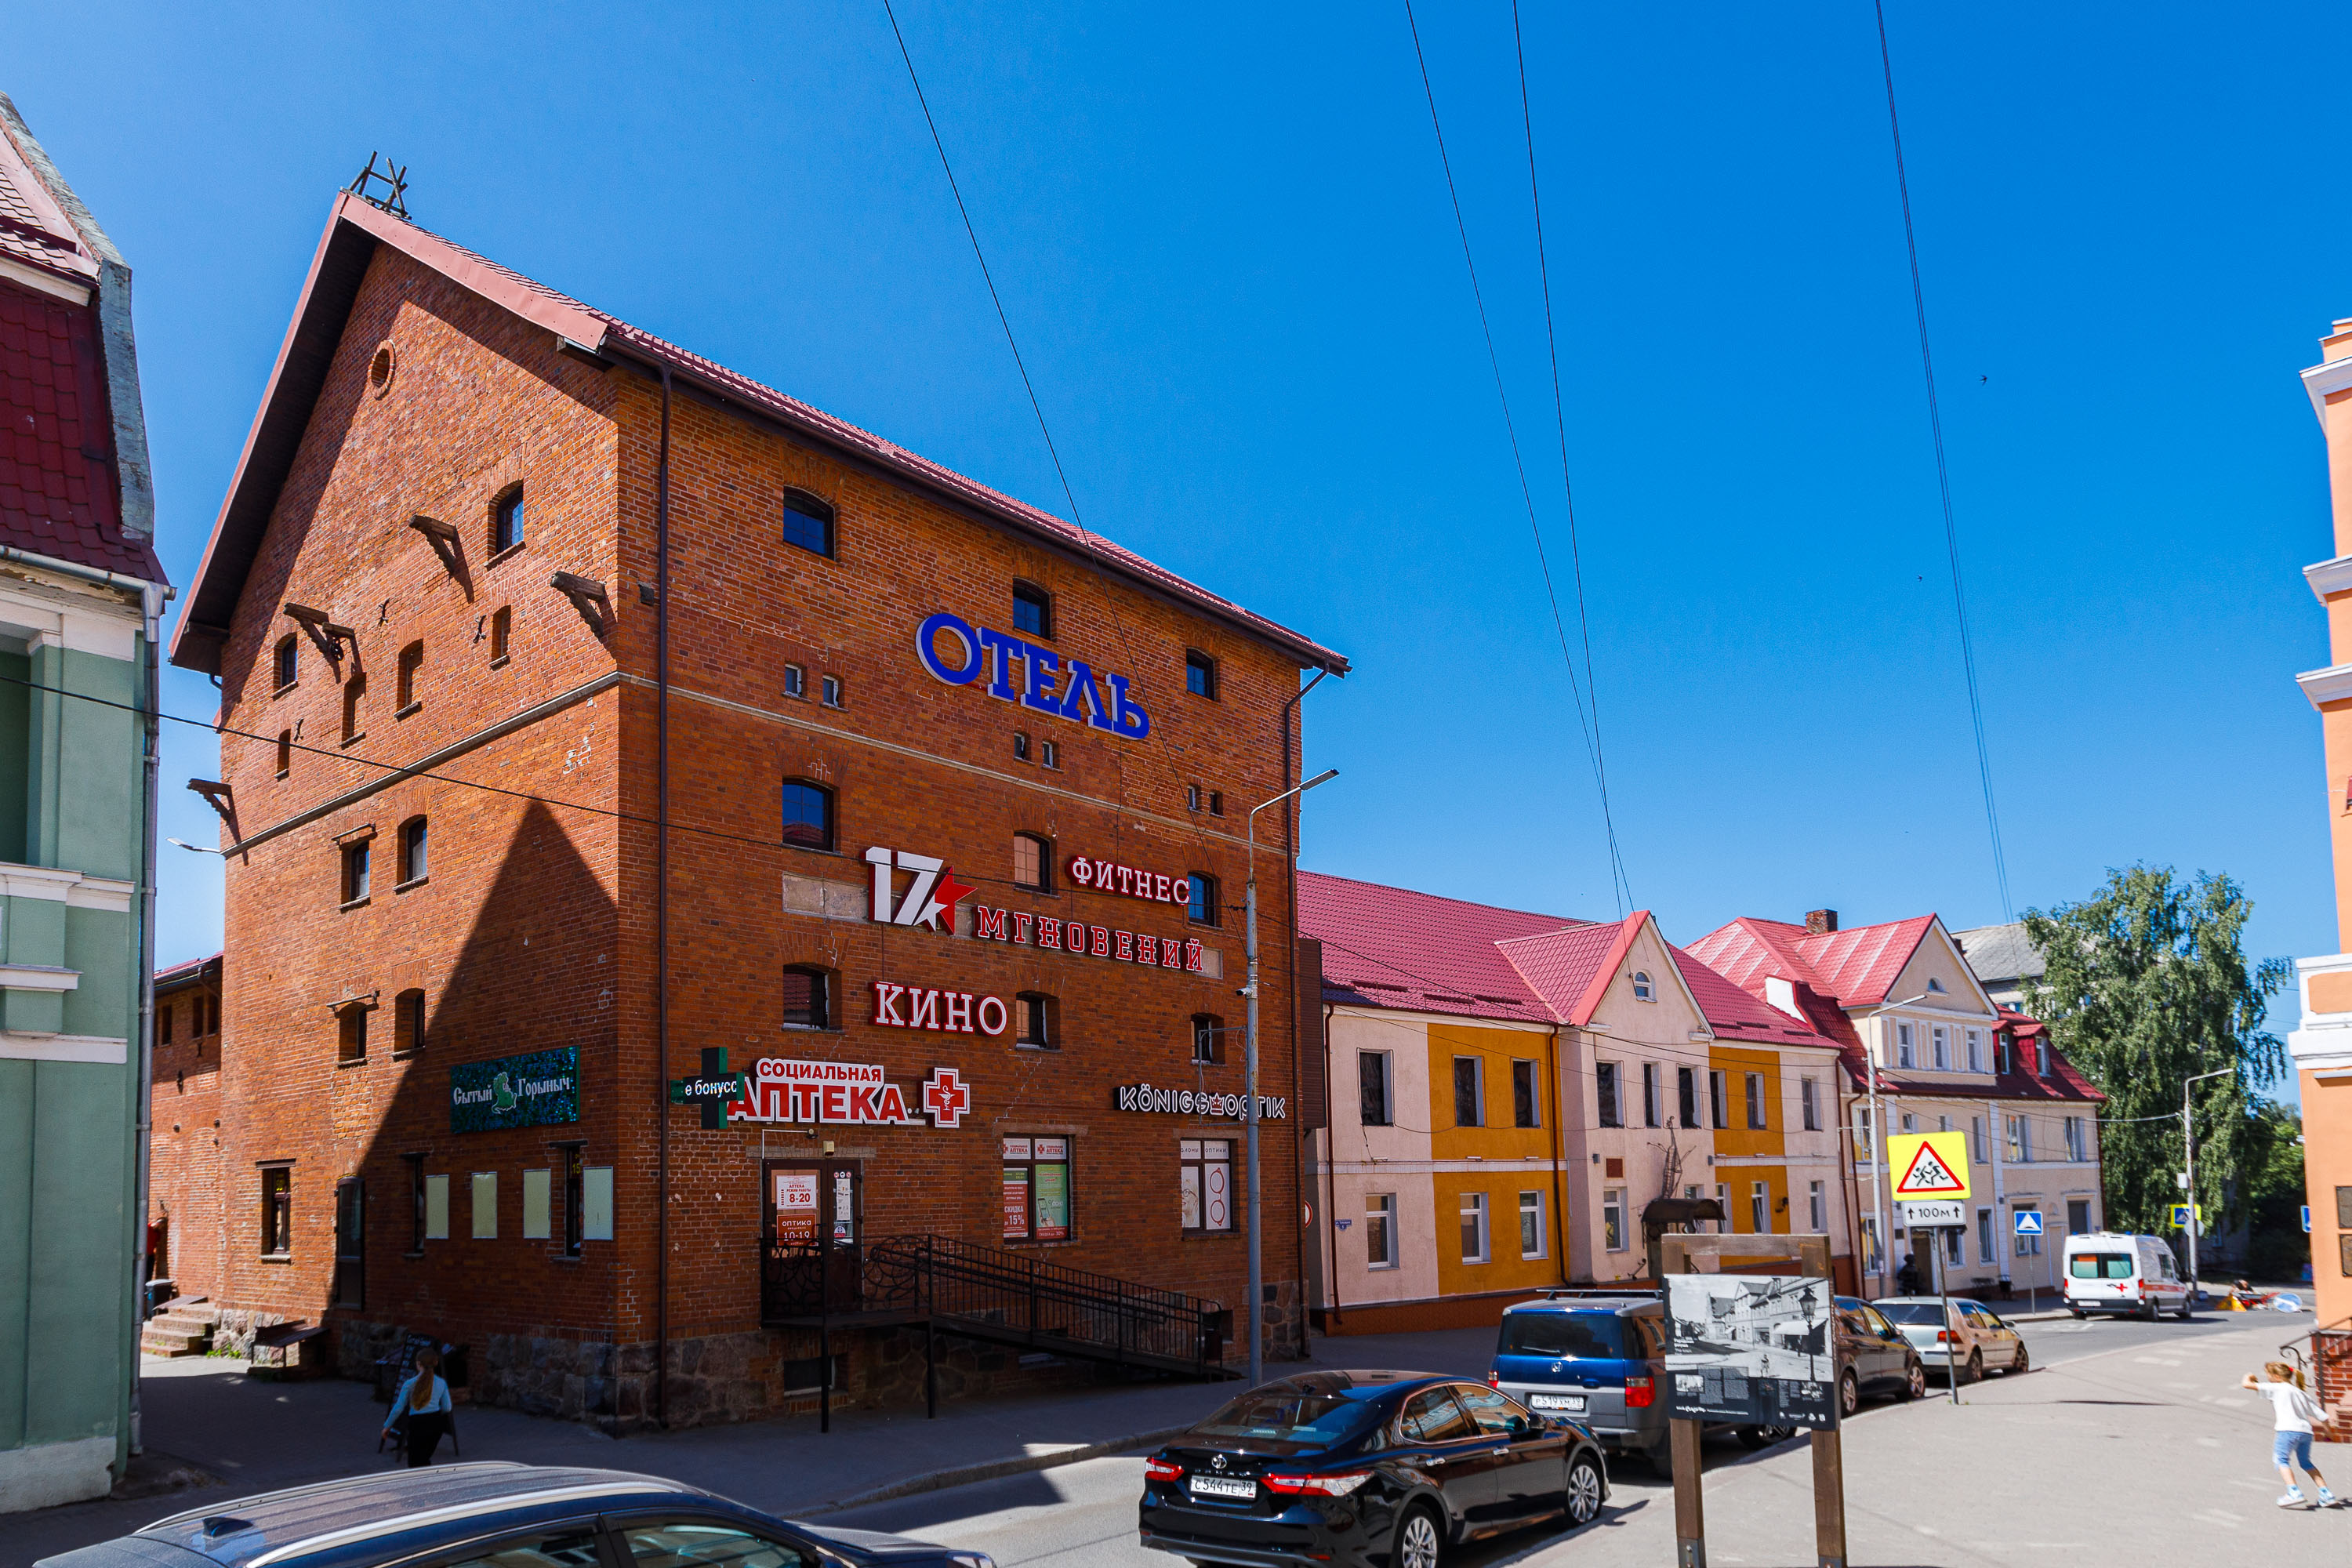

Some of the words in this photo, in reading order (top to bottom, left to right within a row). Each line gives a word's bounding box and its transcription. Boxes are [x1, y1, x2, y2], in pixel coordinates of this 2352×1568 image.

[915, 612, 1150, 740] ОТЕЛЬ
[1069, 855, 1191, 906] ФИТНЕС
[864, 846, 944, 927] 17
[975, 905, 1204, 973] МГНОВЕНИЙ
[873, 982, 1008, 1037] КИНО
[757, 1061, 882, 1083] СОЦИАЛЬНАЯ
[453, 1084, 493, 1105] Сытый
[517, 1076, 571, 1101] Горыныч
[727, 1081, 907, 1123] АПТЕКА
[789, 1192, 811, 1203] 8-20
[1004, 1205, 1024, 1214] СКИДКА
[1009, 1214, 1025, 1225] 15%
[784, 1230, 811, 1241] 10-19
